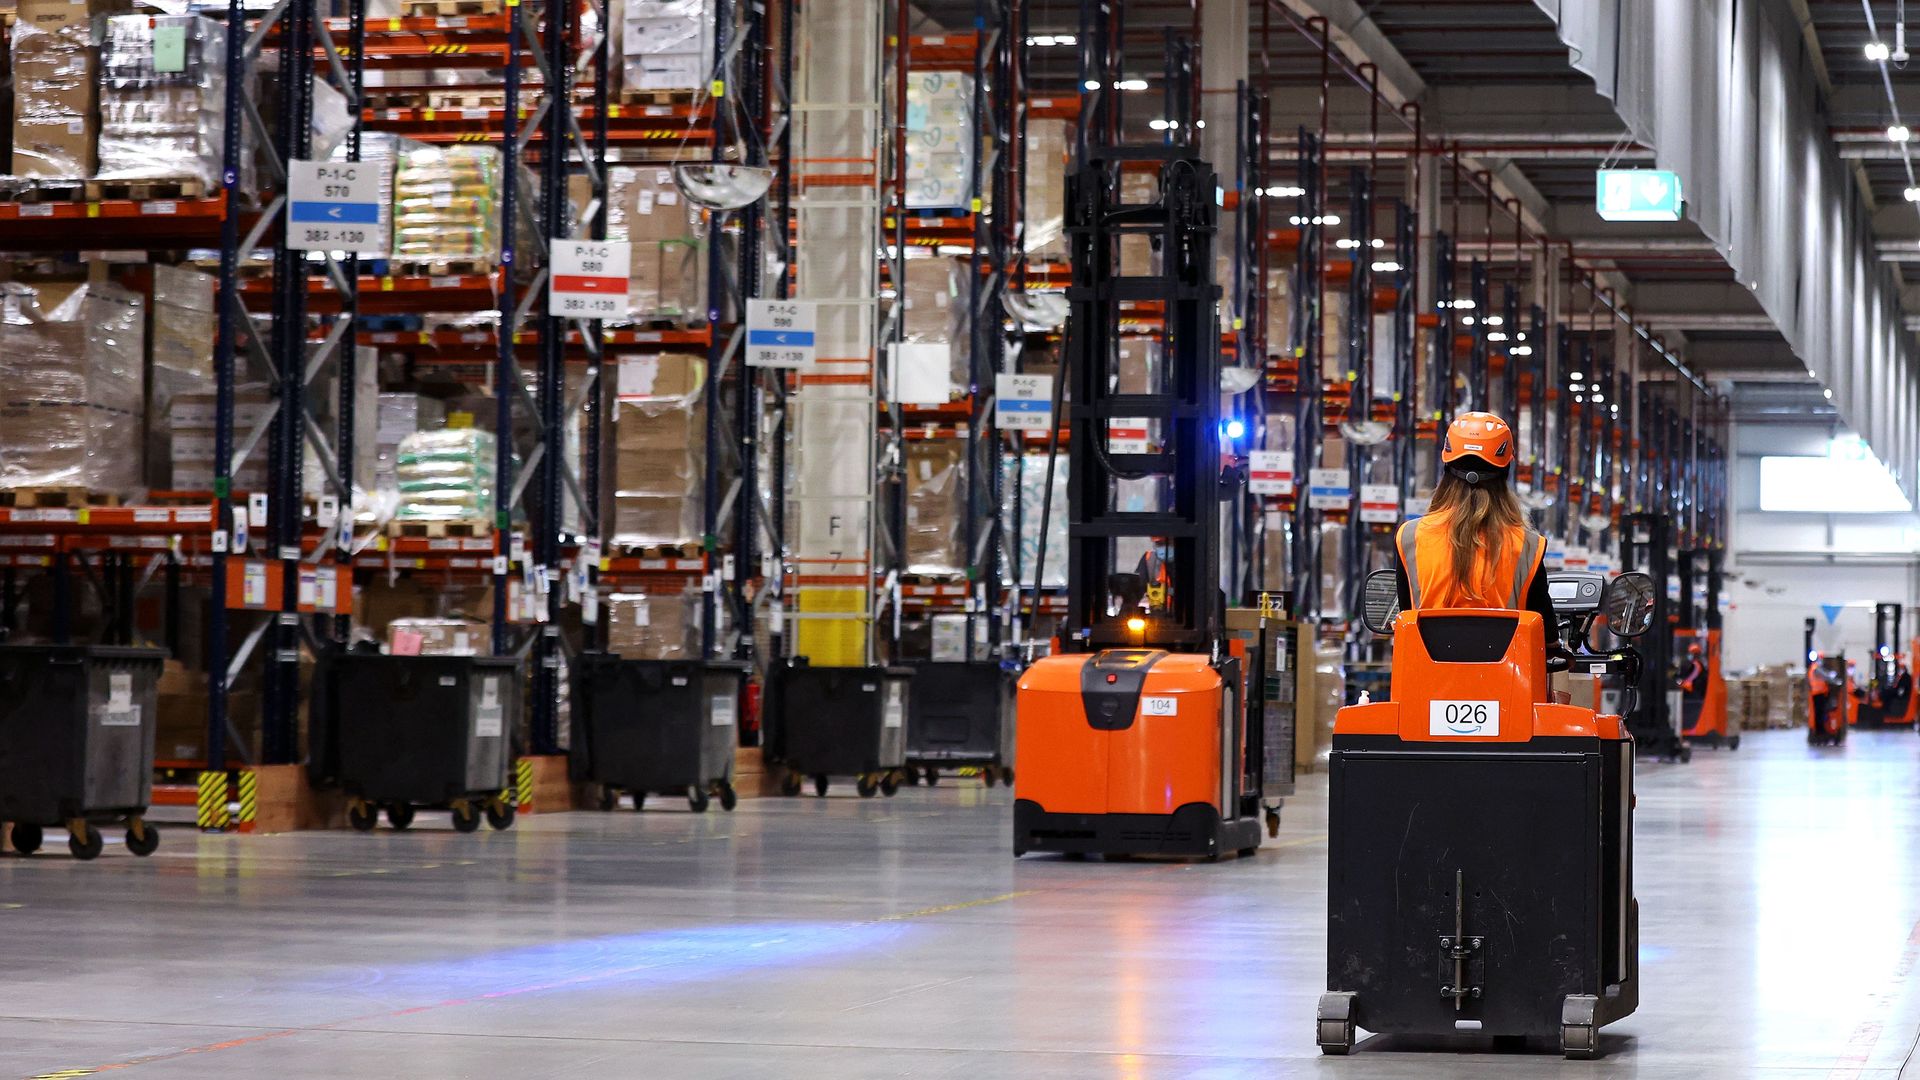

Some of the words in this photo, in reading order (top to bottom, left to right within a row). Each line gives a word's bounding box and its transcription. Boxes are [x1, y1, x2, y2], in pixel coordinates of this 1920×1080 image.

[317, 168, 356, 181] P-1-C
[324, 185, 350, 198] 570
[304, 230, 329, 242] 382
[333, 231, 365, 243] -130
[575, 247, 609, 258] P-1-C
[581, 261, 603, 272] 580
[564, 300, 586, 310] 382
[589, 301, 615, 311] -130
[767, 305, 797, 316] P-1-C
[829, 516, 841, 537] F
[829, 551, 843, 571] 7
[1150, 700, 1170, 711] 104
[1445, 704, 1487, 724] 026
